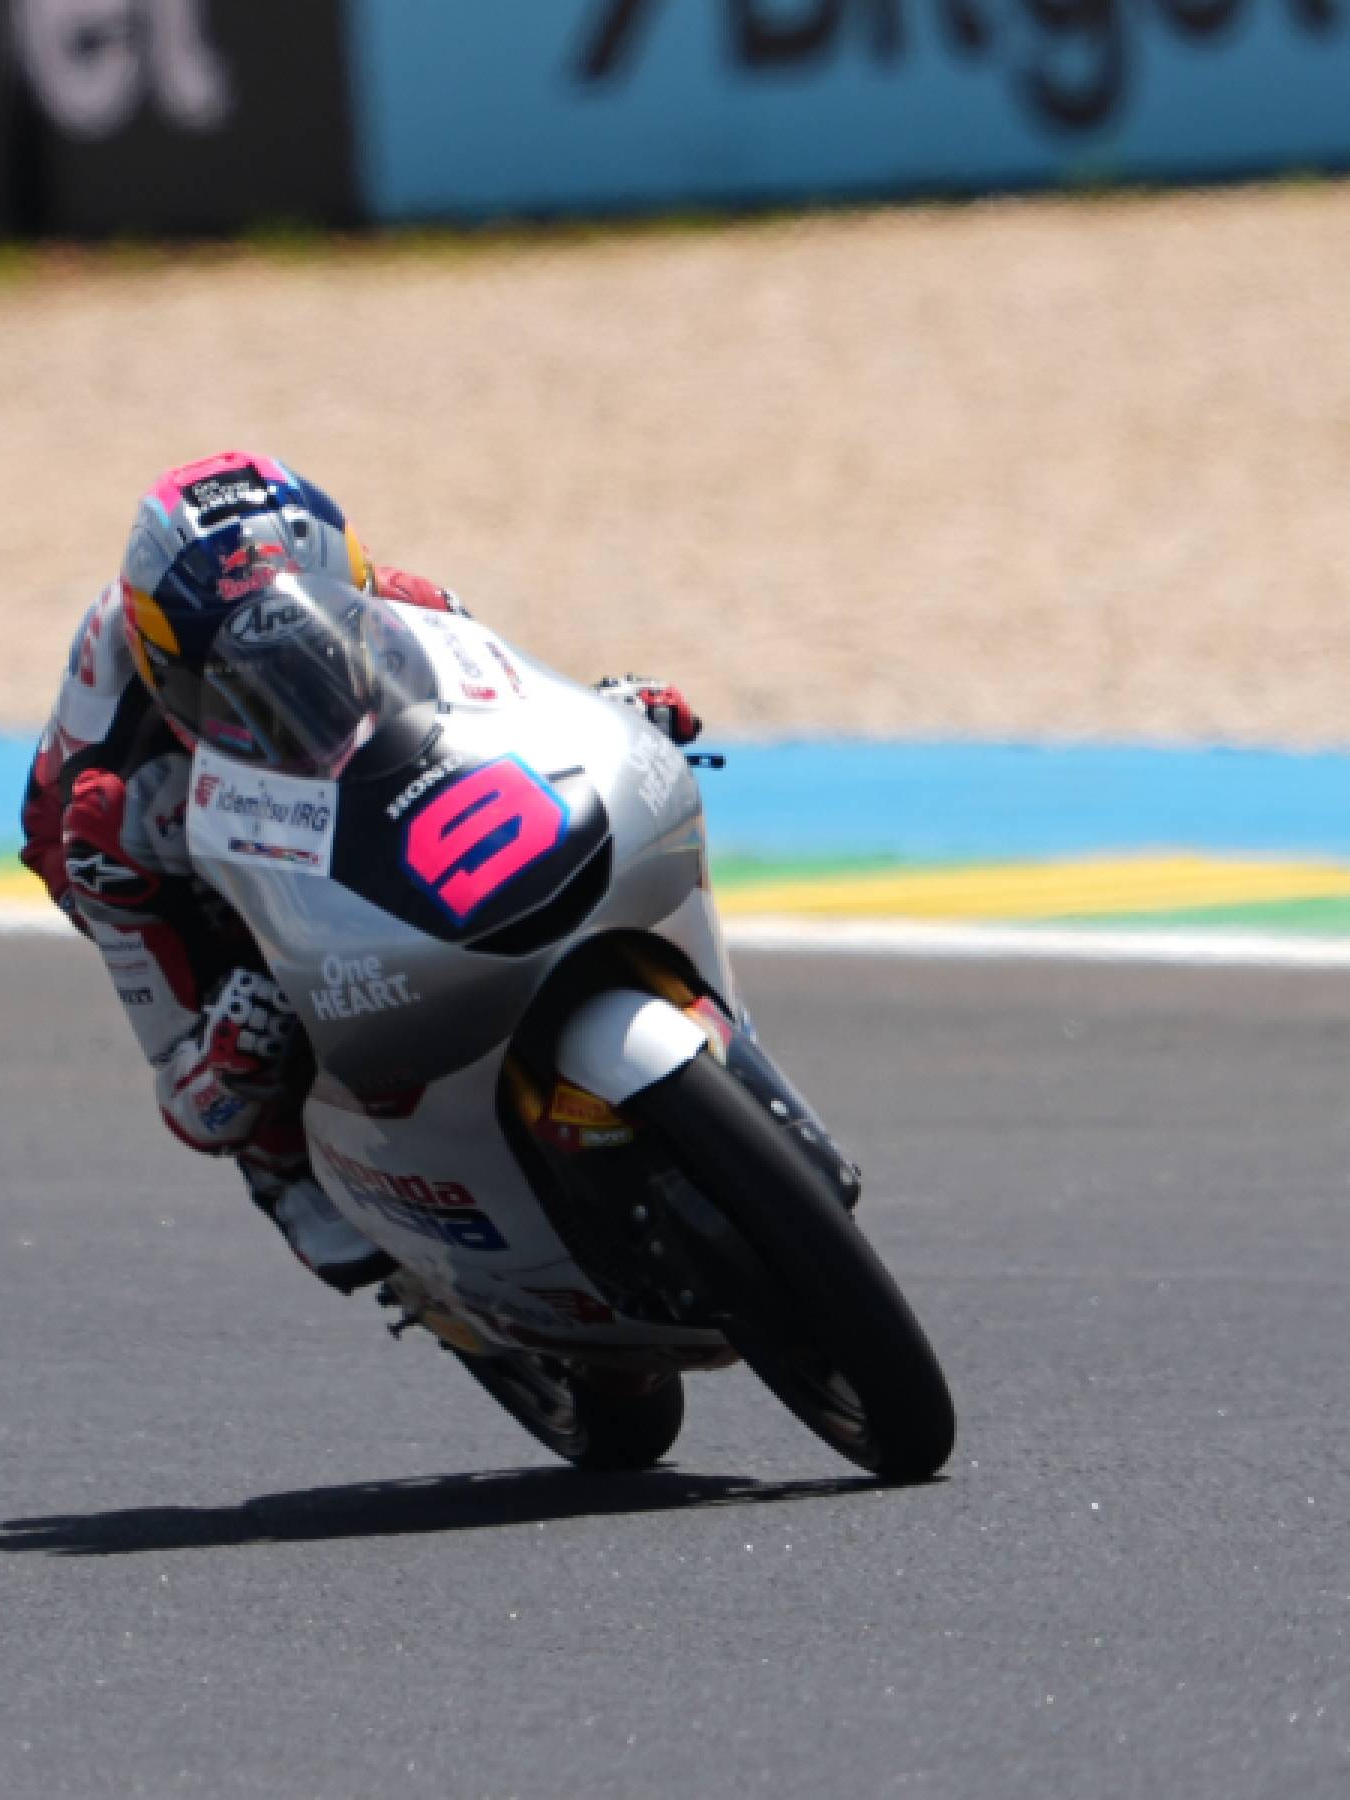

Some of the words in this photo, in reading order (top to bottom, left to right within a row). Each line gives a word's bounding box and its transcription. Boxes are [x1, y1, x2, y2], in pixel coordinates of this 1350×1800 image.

[386, 757, 468, 820] HOND
[290, 800, 331, 832] IRG
[405, 755, 566, 923] 9
[322, 953, 381, 985] One
